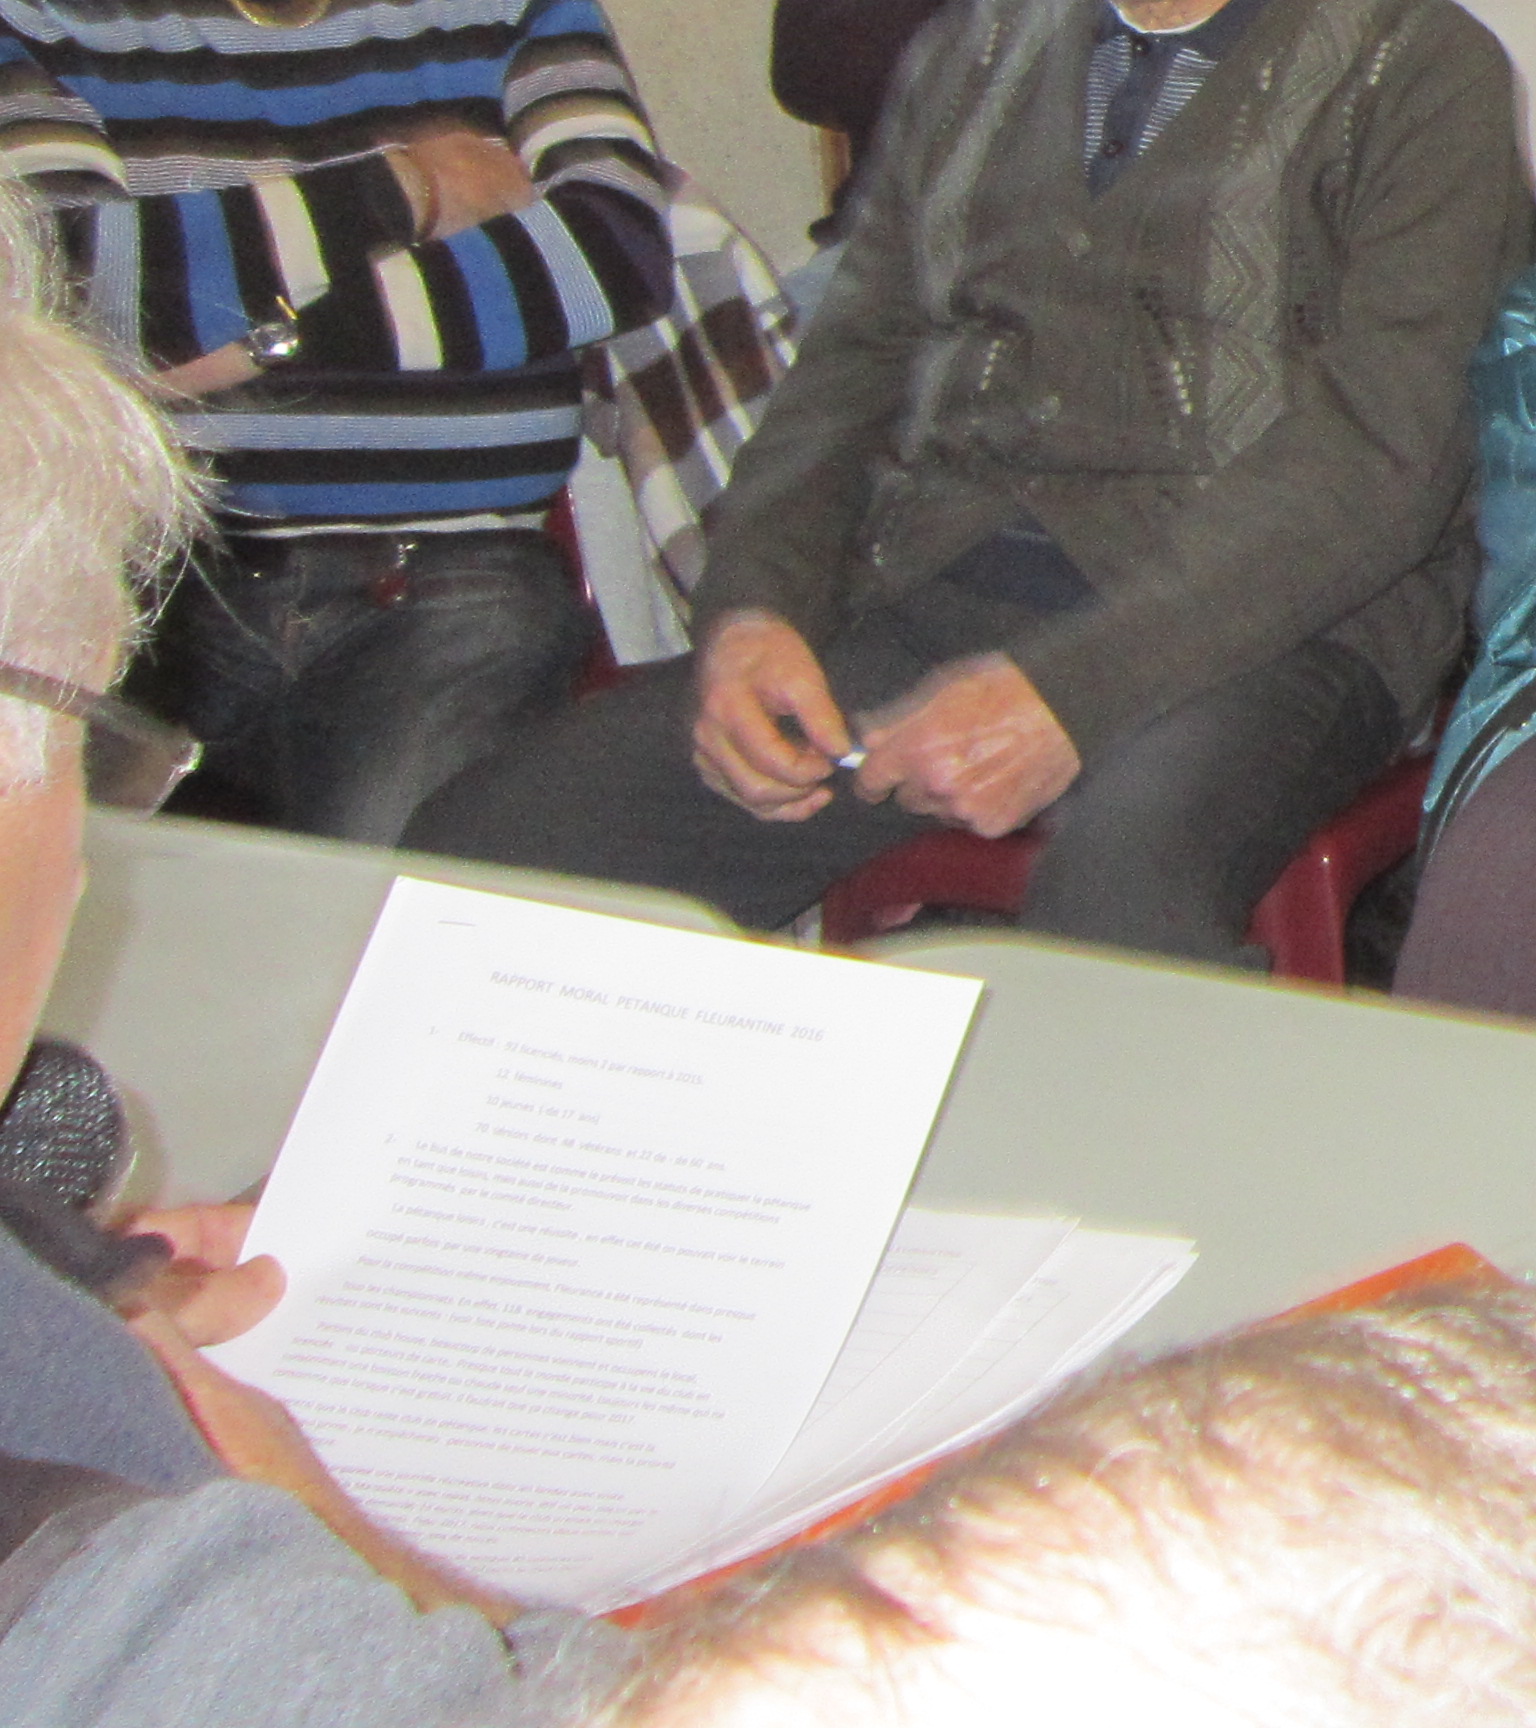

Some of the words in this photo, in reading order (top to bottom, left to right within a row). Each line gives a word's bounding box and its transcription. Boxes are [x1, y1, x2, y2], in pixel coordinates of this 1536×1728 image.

[488, 970, 555, 993] RAPPORT
[558, 985, 611, 1004] MORAL
[615, 995, 690, 1019] PETANQUE
[694, 1009, 786, 1035] FLEURANTINE
[789, 1024, 826, 1042] 2016
